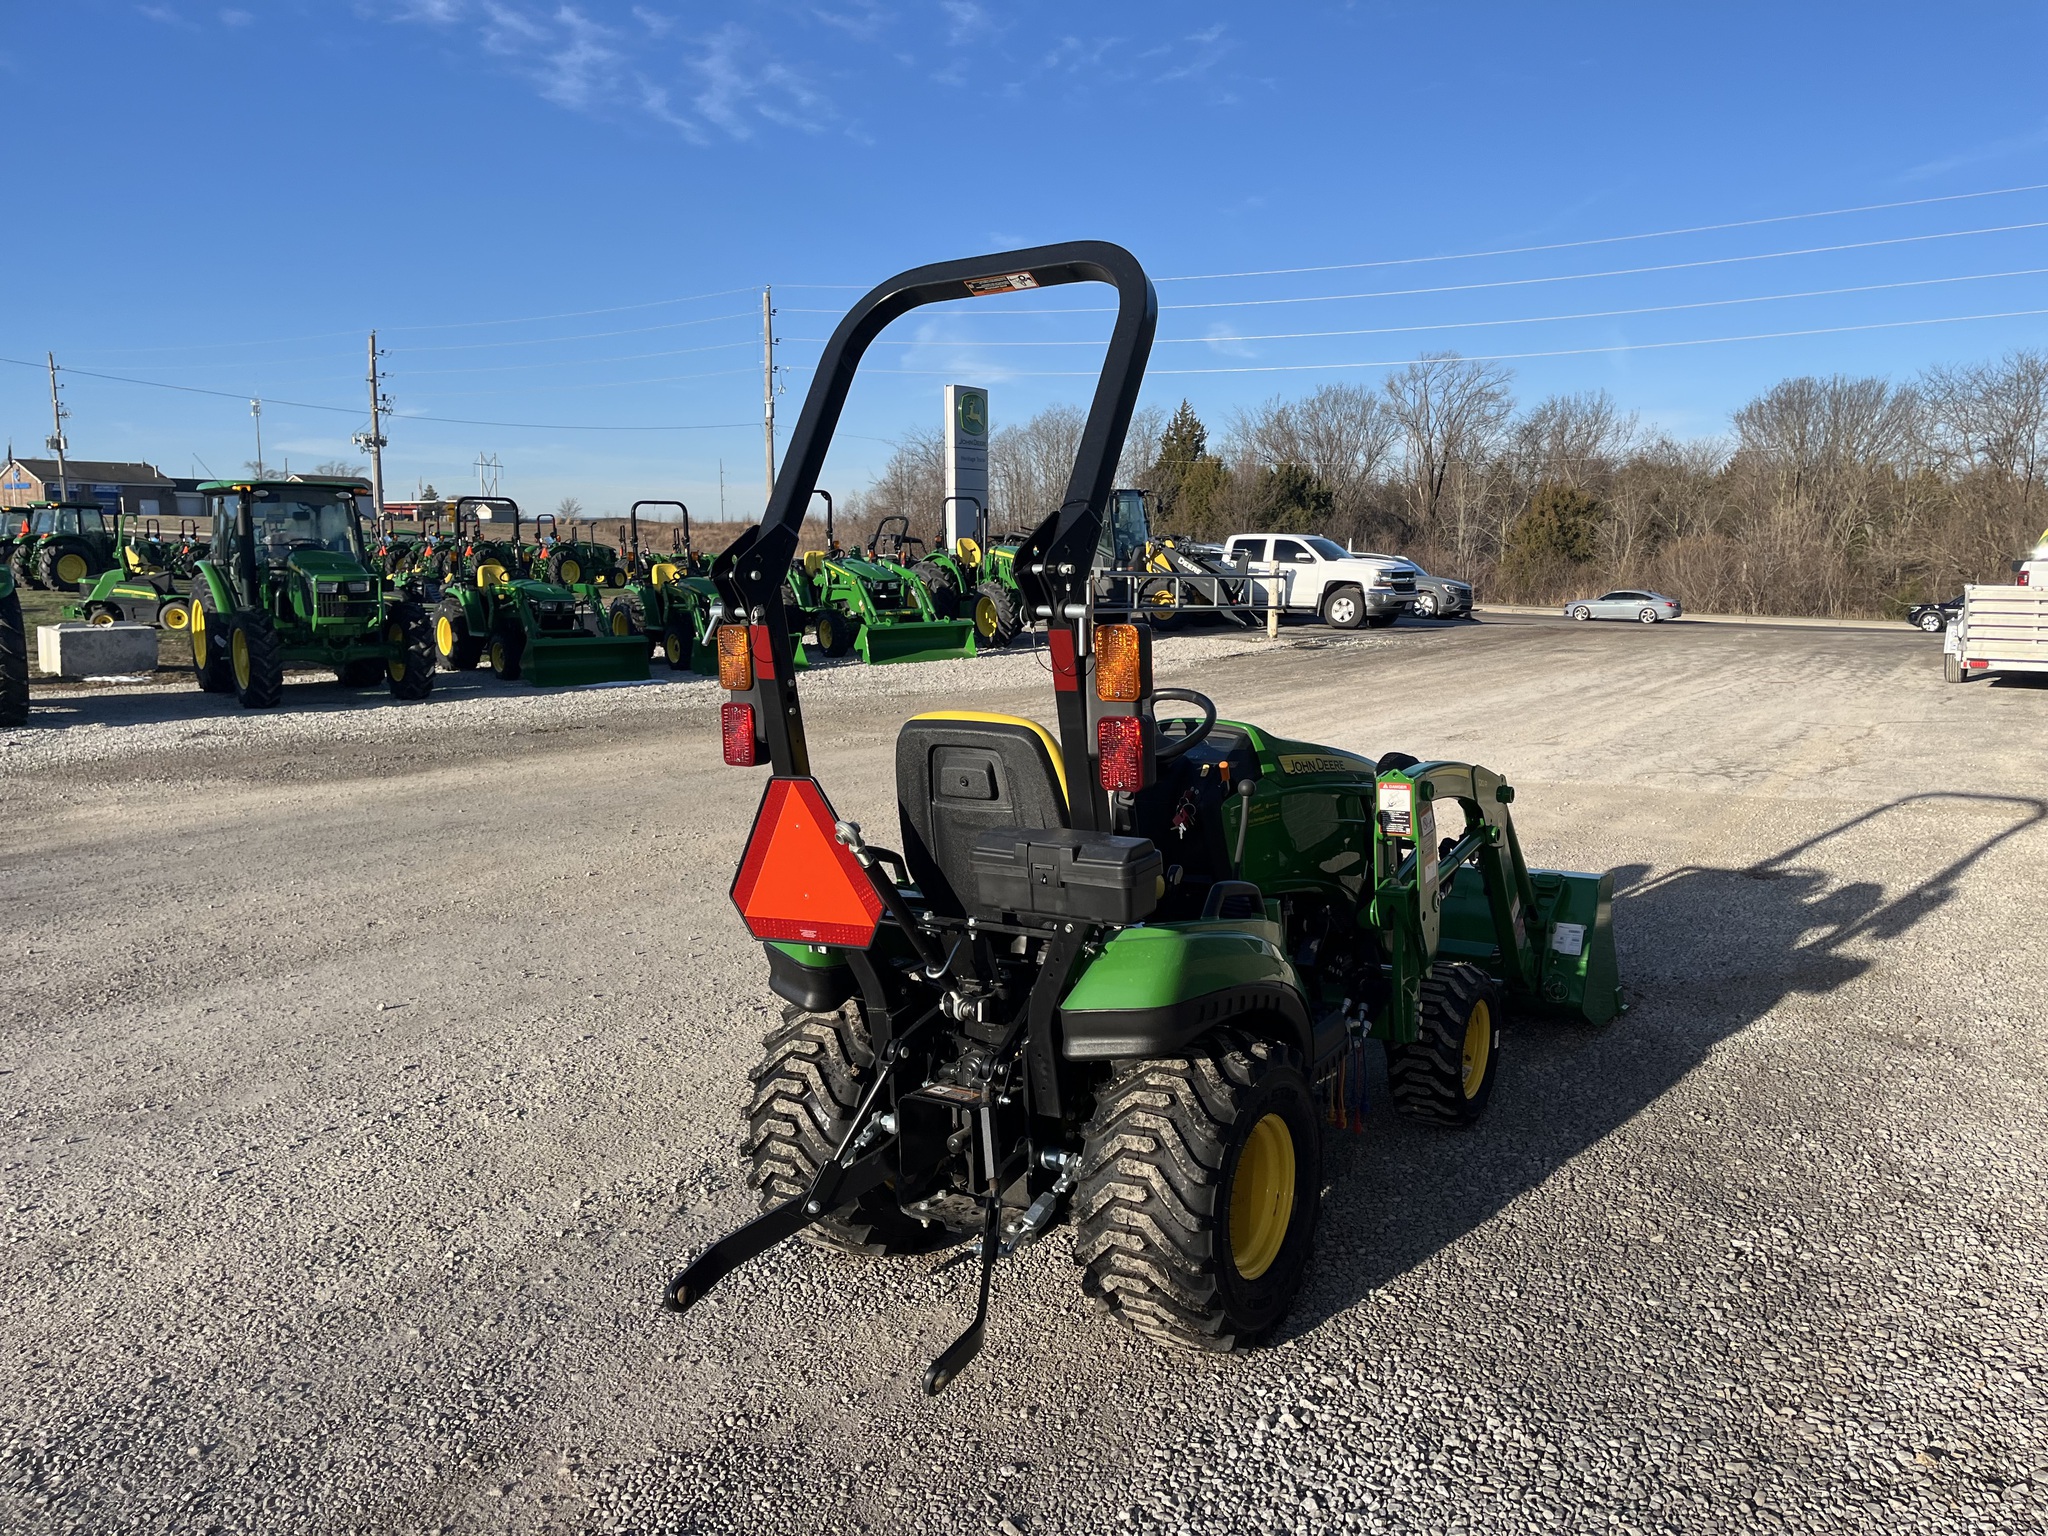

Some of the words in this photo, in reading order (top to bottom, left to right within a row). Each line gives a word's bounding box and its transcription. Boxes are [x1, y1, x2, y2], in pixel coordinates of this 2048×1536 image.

[1177, 556, 1203, 574] DEERE
[1290, 759, 1316, 773] JOHN
[1316, 758, 1345, 771] DEERE
